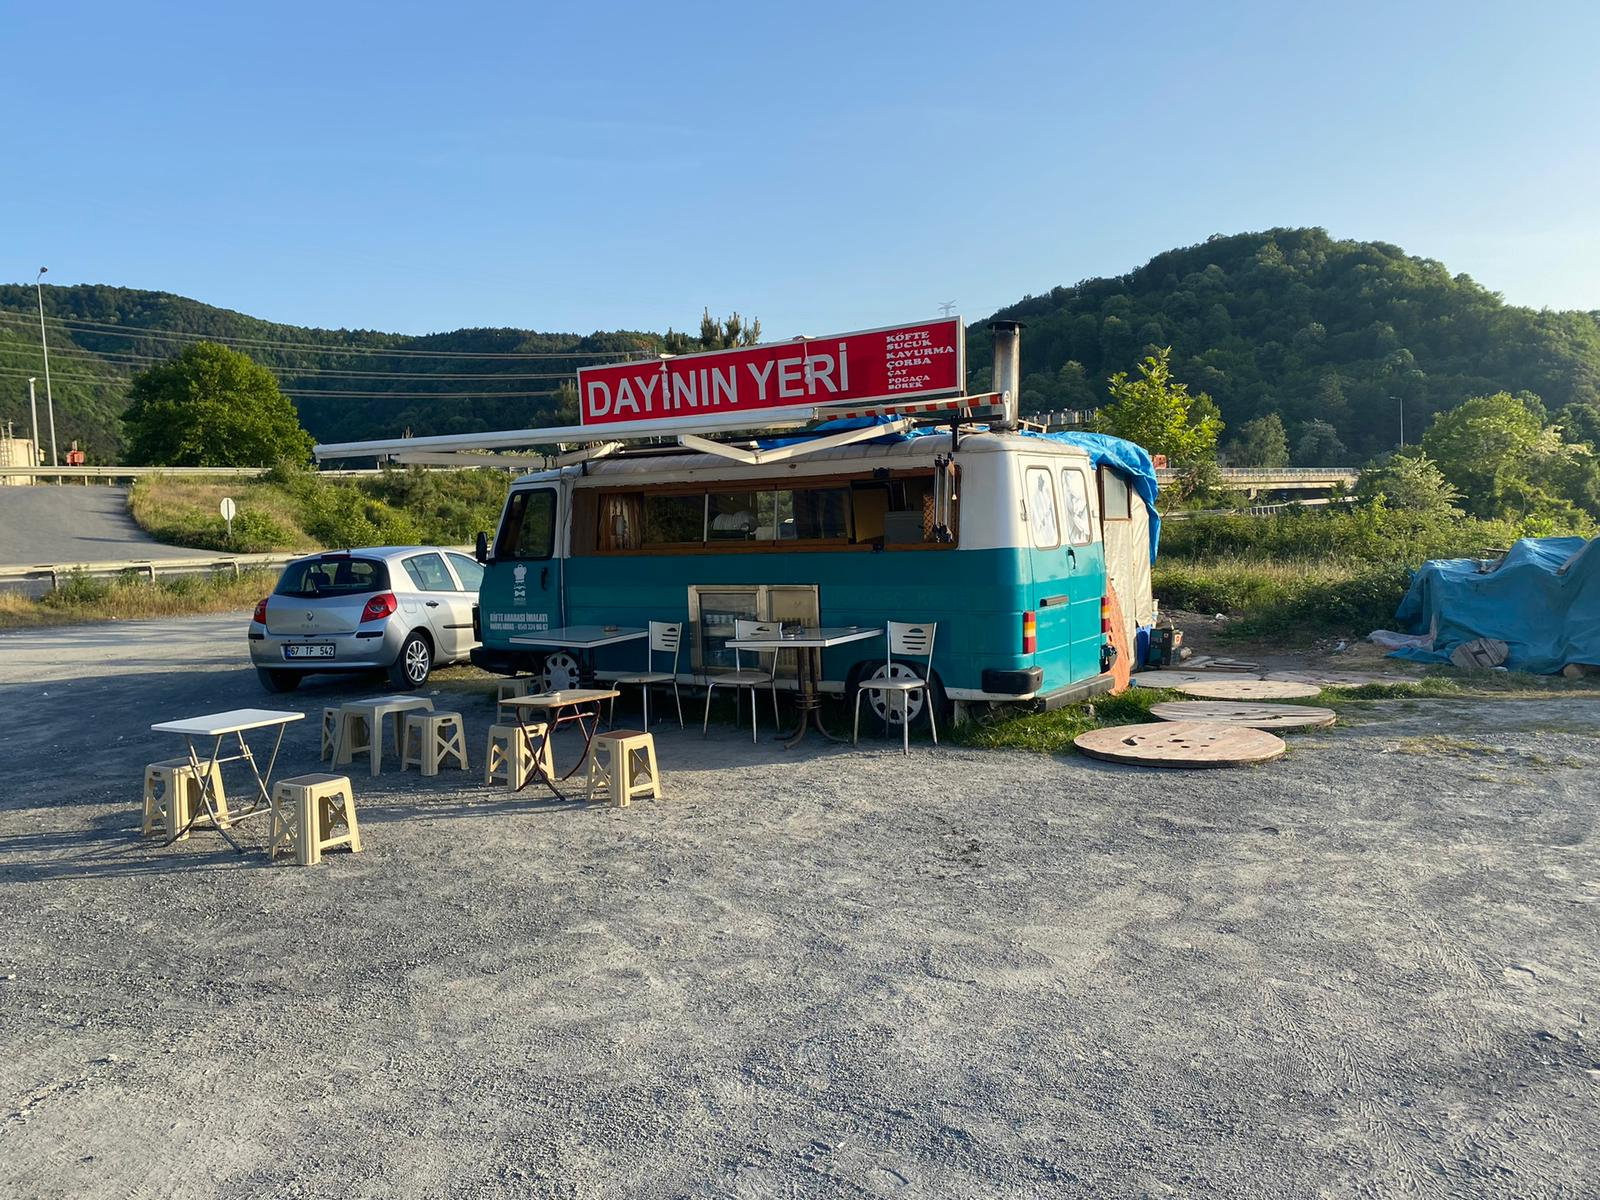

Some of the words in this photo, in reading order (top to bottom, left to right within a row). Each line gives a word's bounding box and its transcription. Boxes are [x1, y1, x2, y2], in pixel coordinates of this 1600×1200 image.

[886, 331, 930, 343] KÖFTE
[886, 339, 932, 351] SUCUK
[886, 345, 955, 359] KAVURMA
[886, 357, 932, 370] ÇORBA
[747, 342, 849, 401] YERİ
[887, 369, 908, 378] ÇAY
[291, 646, 299, 656] 67
[306, 646, 315, 656] TF
[320, 646, 333, 656] 542
